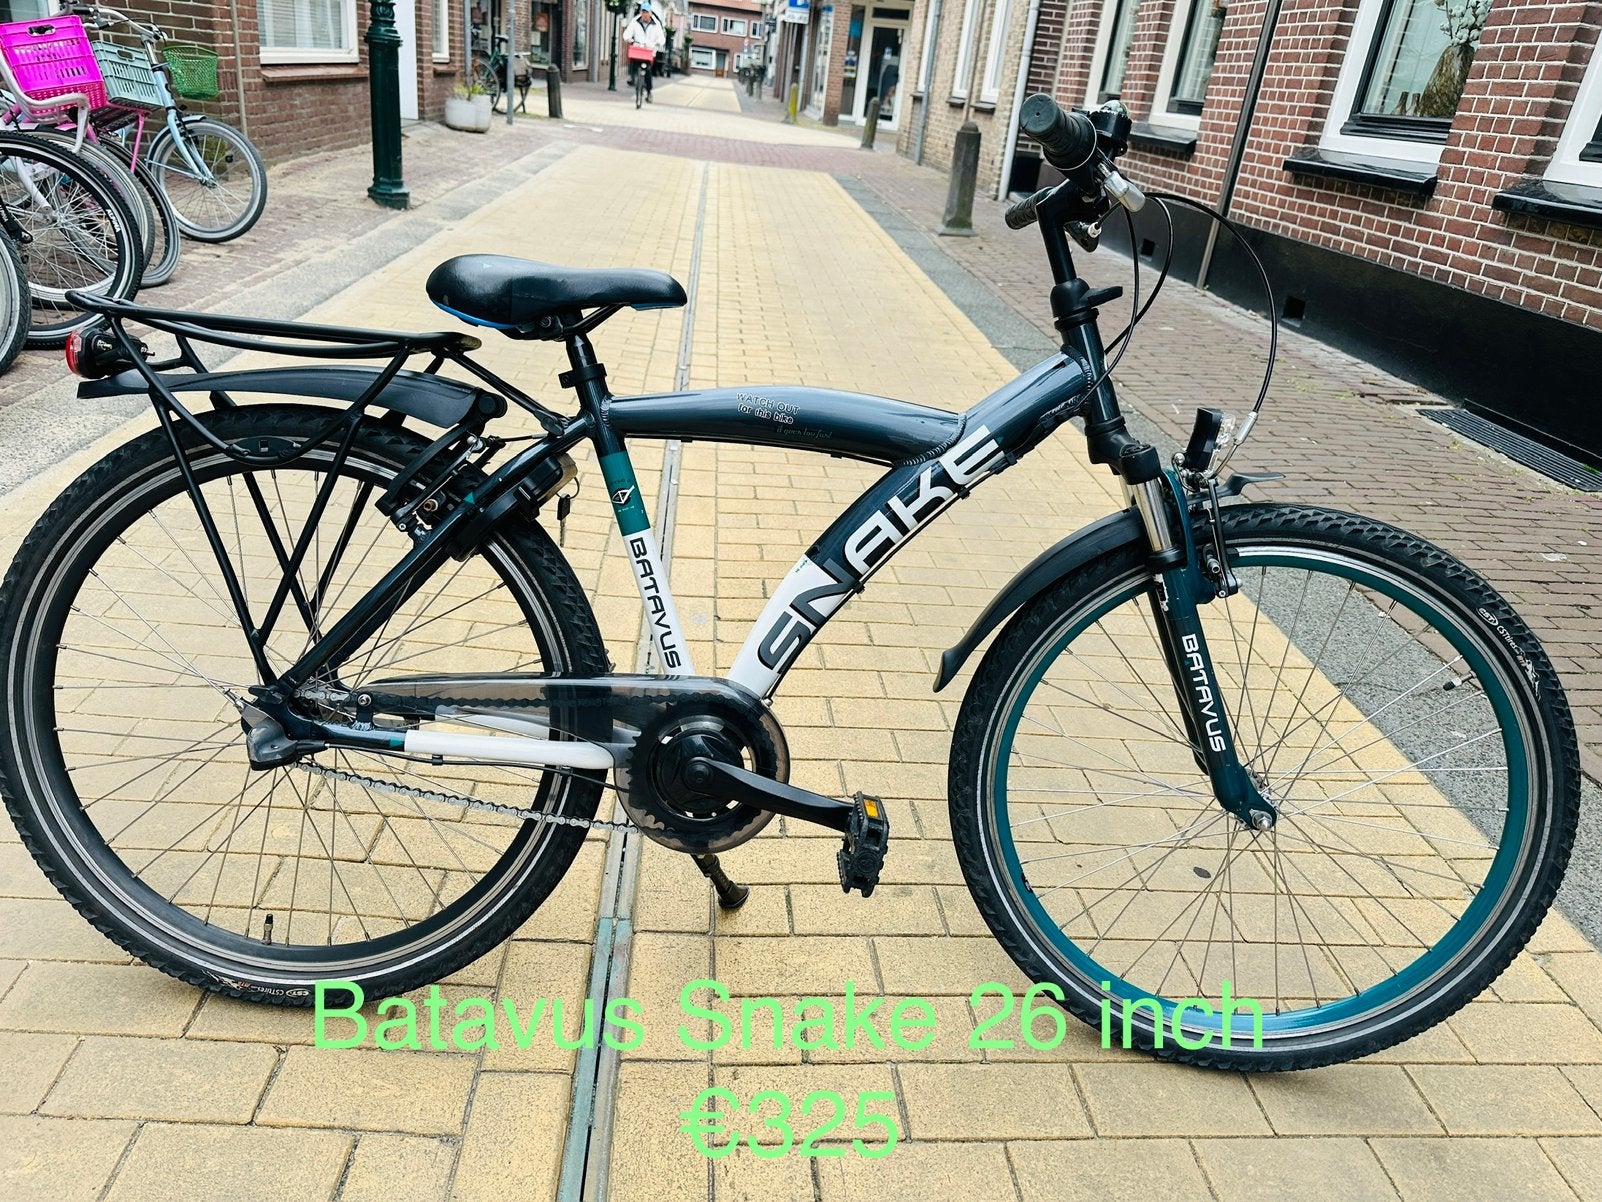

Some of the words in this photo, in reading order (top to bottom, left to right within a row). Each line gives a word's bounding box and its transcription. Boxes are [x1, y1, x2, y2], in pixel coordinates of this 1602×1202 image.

[736, 392, 774, 409] WATCH
[776, 401, 800, 415] OUT
[738, 403, 752, 414] for
[754, 407, 772, 420] this
[773, 411, 794, 425] bike
[757, 424, 1006, 674] SNAKE
[629, 537, 682, 669] BATAVUS
[1478, 607, 1499, 626] CST
[1181, 633, 1227, 753] BATAVUS
[285, 987, 310, 998] CST
